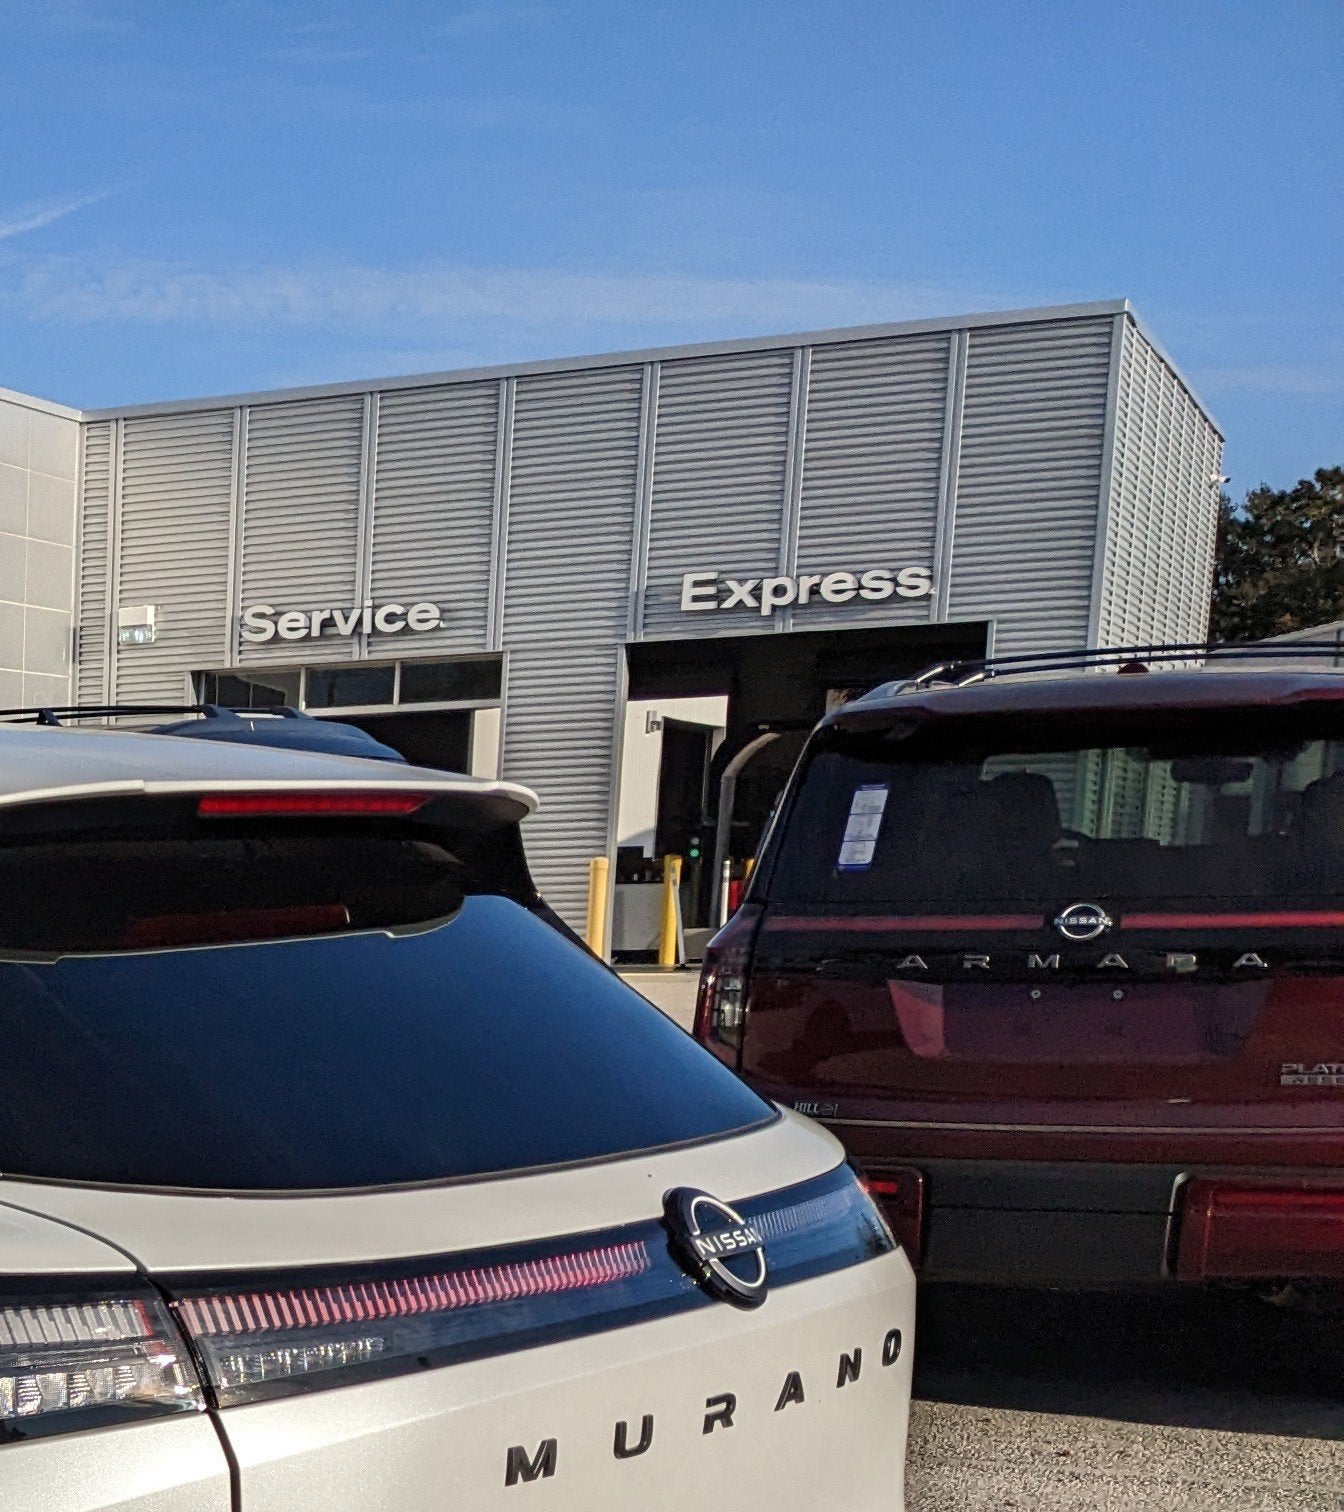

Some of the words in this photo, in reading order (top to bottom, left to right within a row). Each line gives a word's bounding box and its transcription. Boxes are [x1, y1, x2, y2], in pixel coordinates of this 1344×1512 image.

[680, 566, 933, 616] Express
[241, 599, 441, 642] Service
[505, 1328, 903, 1487] MURANO
